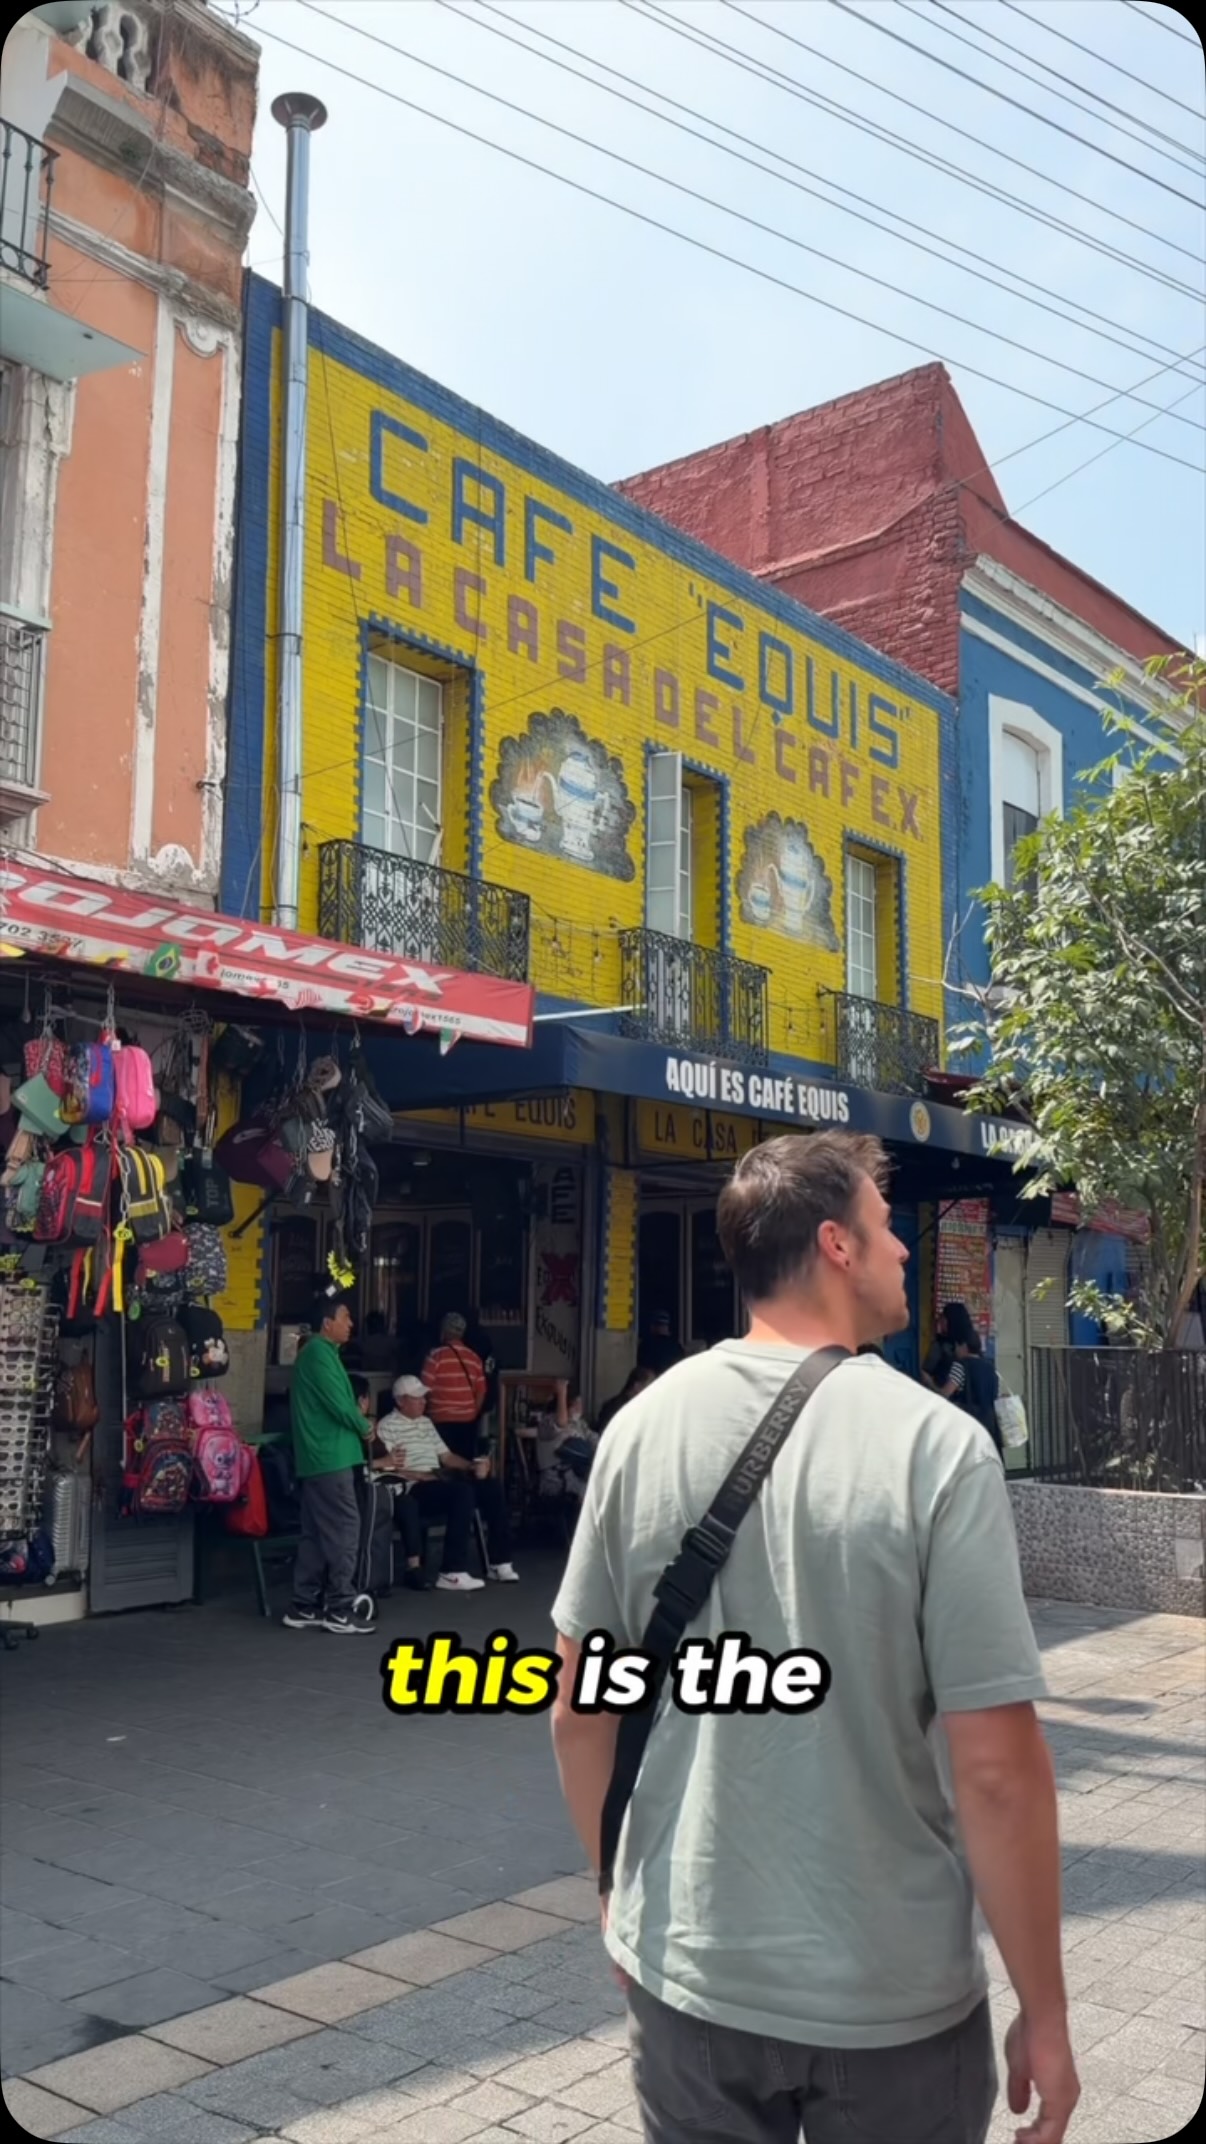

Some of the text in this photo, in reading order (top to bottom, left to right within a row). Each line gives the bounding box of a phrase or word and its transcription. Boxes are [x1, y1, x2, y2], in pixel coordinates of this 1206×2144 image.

[370, 409, 635, 635] CAFE
[322, 497, 422, 609] LA
[454, 566, 631, 706] CASA
[654, 666, 755, 766] DEL
[655, 1110, 677, 1145] LA
[665, 1056, 850, 1124] AQUÍ ES CAFÉ EQUIS
